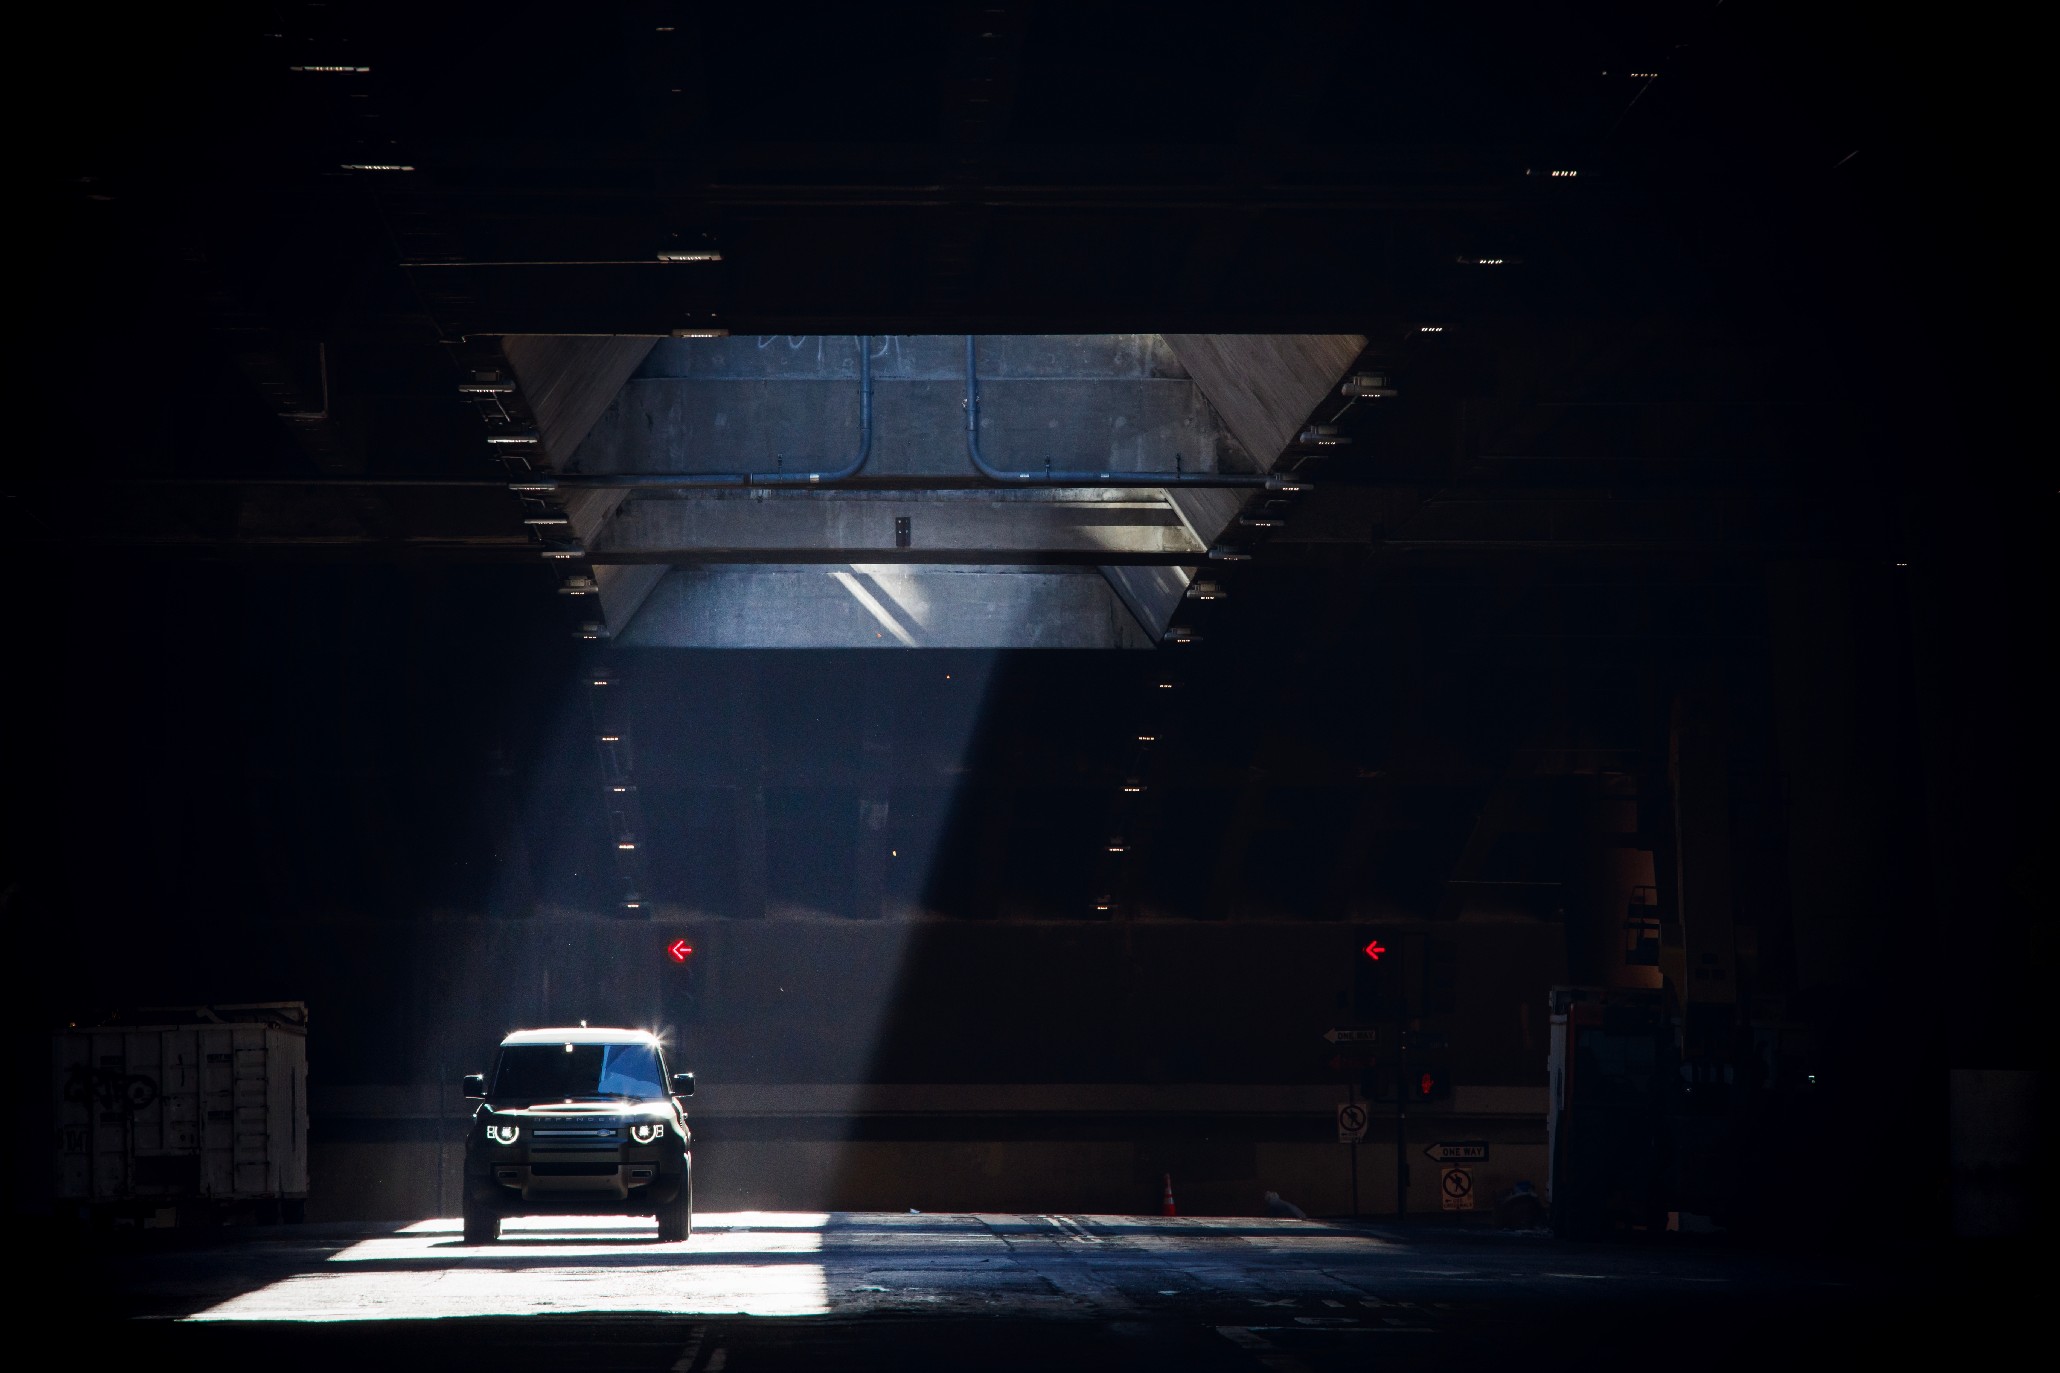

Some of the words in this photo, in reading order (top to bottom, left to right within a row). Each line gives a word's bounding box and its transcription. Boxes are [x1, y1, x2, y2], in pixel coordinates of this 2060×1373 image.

[1337, 1031, 1353, 1039] ONE
[1356, 1031, 1374, 1039] WAY
[1442, 1147, 1461, 1156] ONE
[1463, 1147, 1482, 1156] WAY
